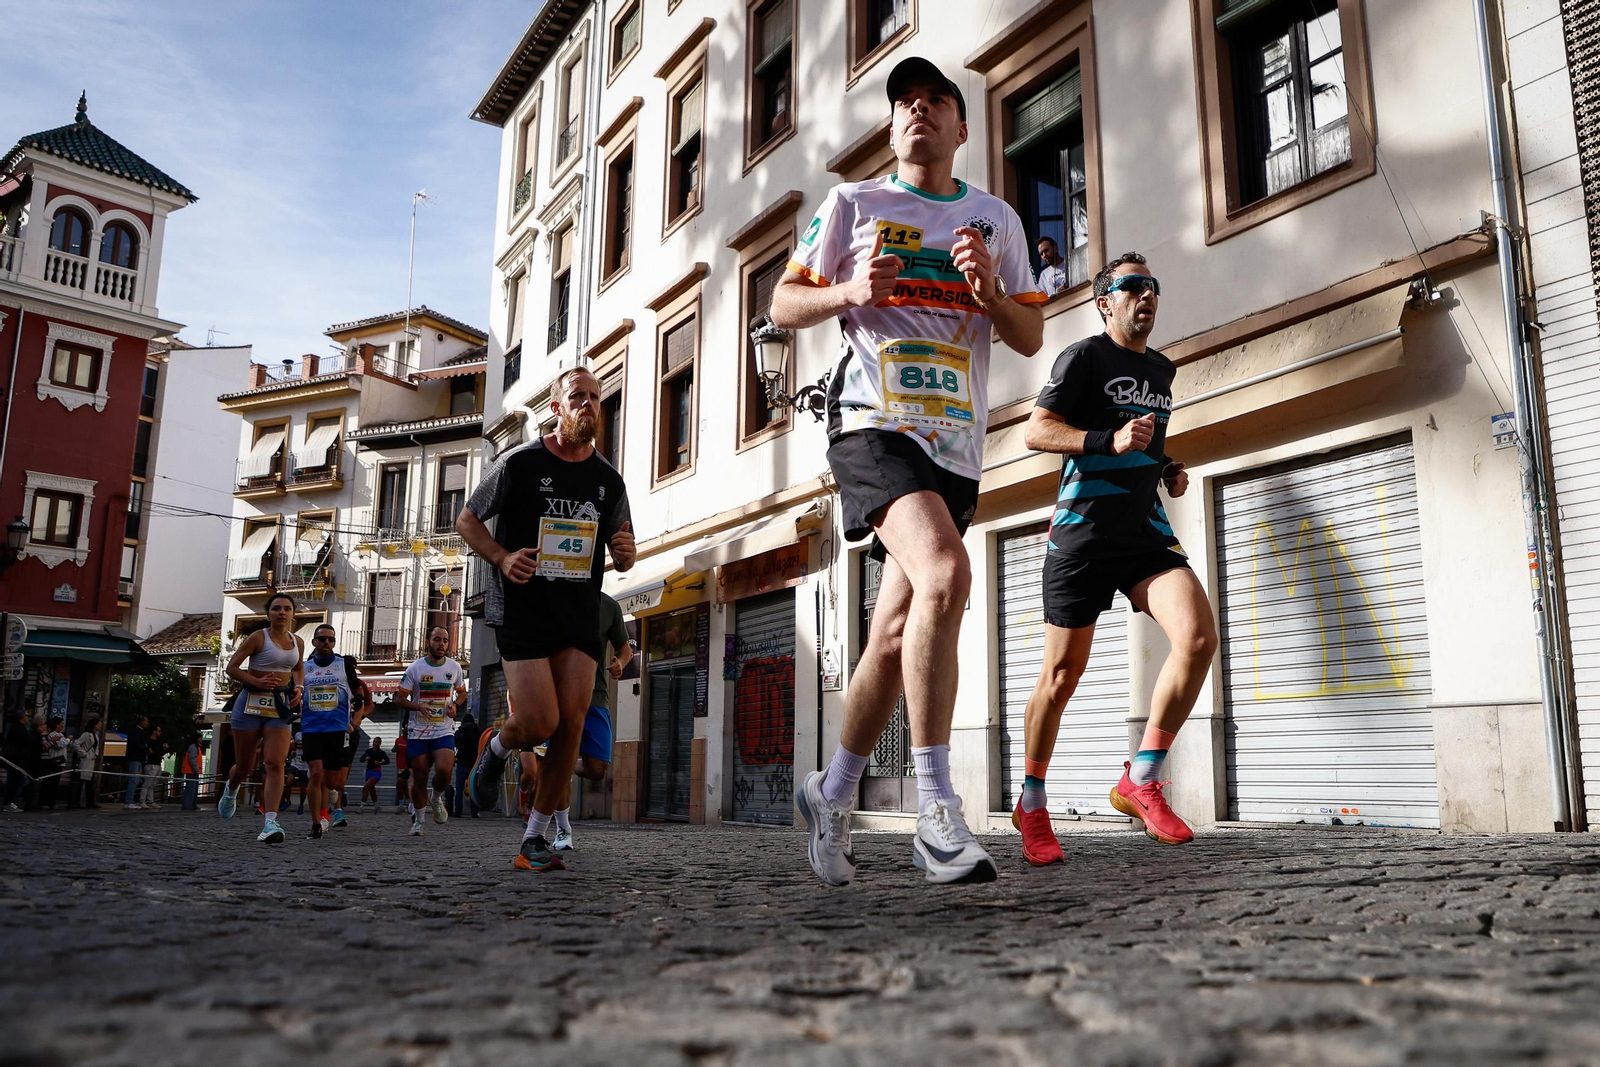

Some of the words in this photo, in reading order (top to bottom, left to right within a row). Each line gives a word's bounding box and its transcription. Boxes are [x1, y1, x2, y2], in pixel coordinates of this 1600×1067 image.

[936, 350, 967, 362] UNIVERSIDAD
[900, 366, 958, 393] 818
[544, 498, 580, 516] XIV
[558, 538, 583, 553] 45
[626, 599, 634, 612] LA
[636, 594, 650, 606] PEPA
[376, 680, 399, 689] Especias
[259, 697, 273, 707] 61
